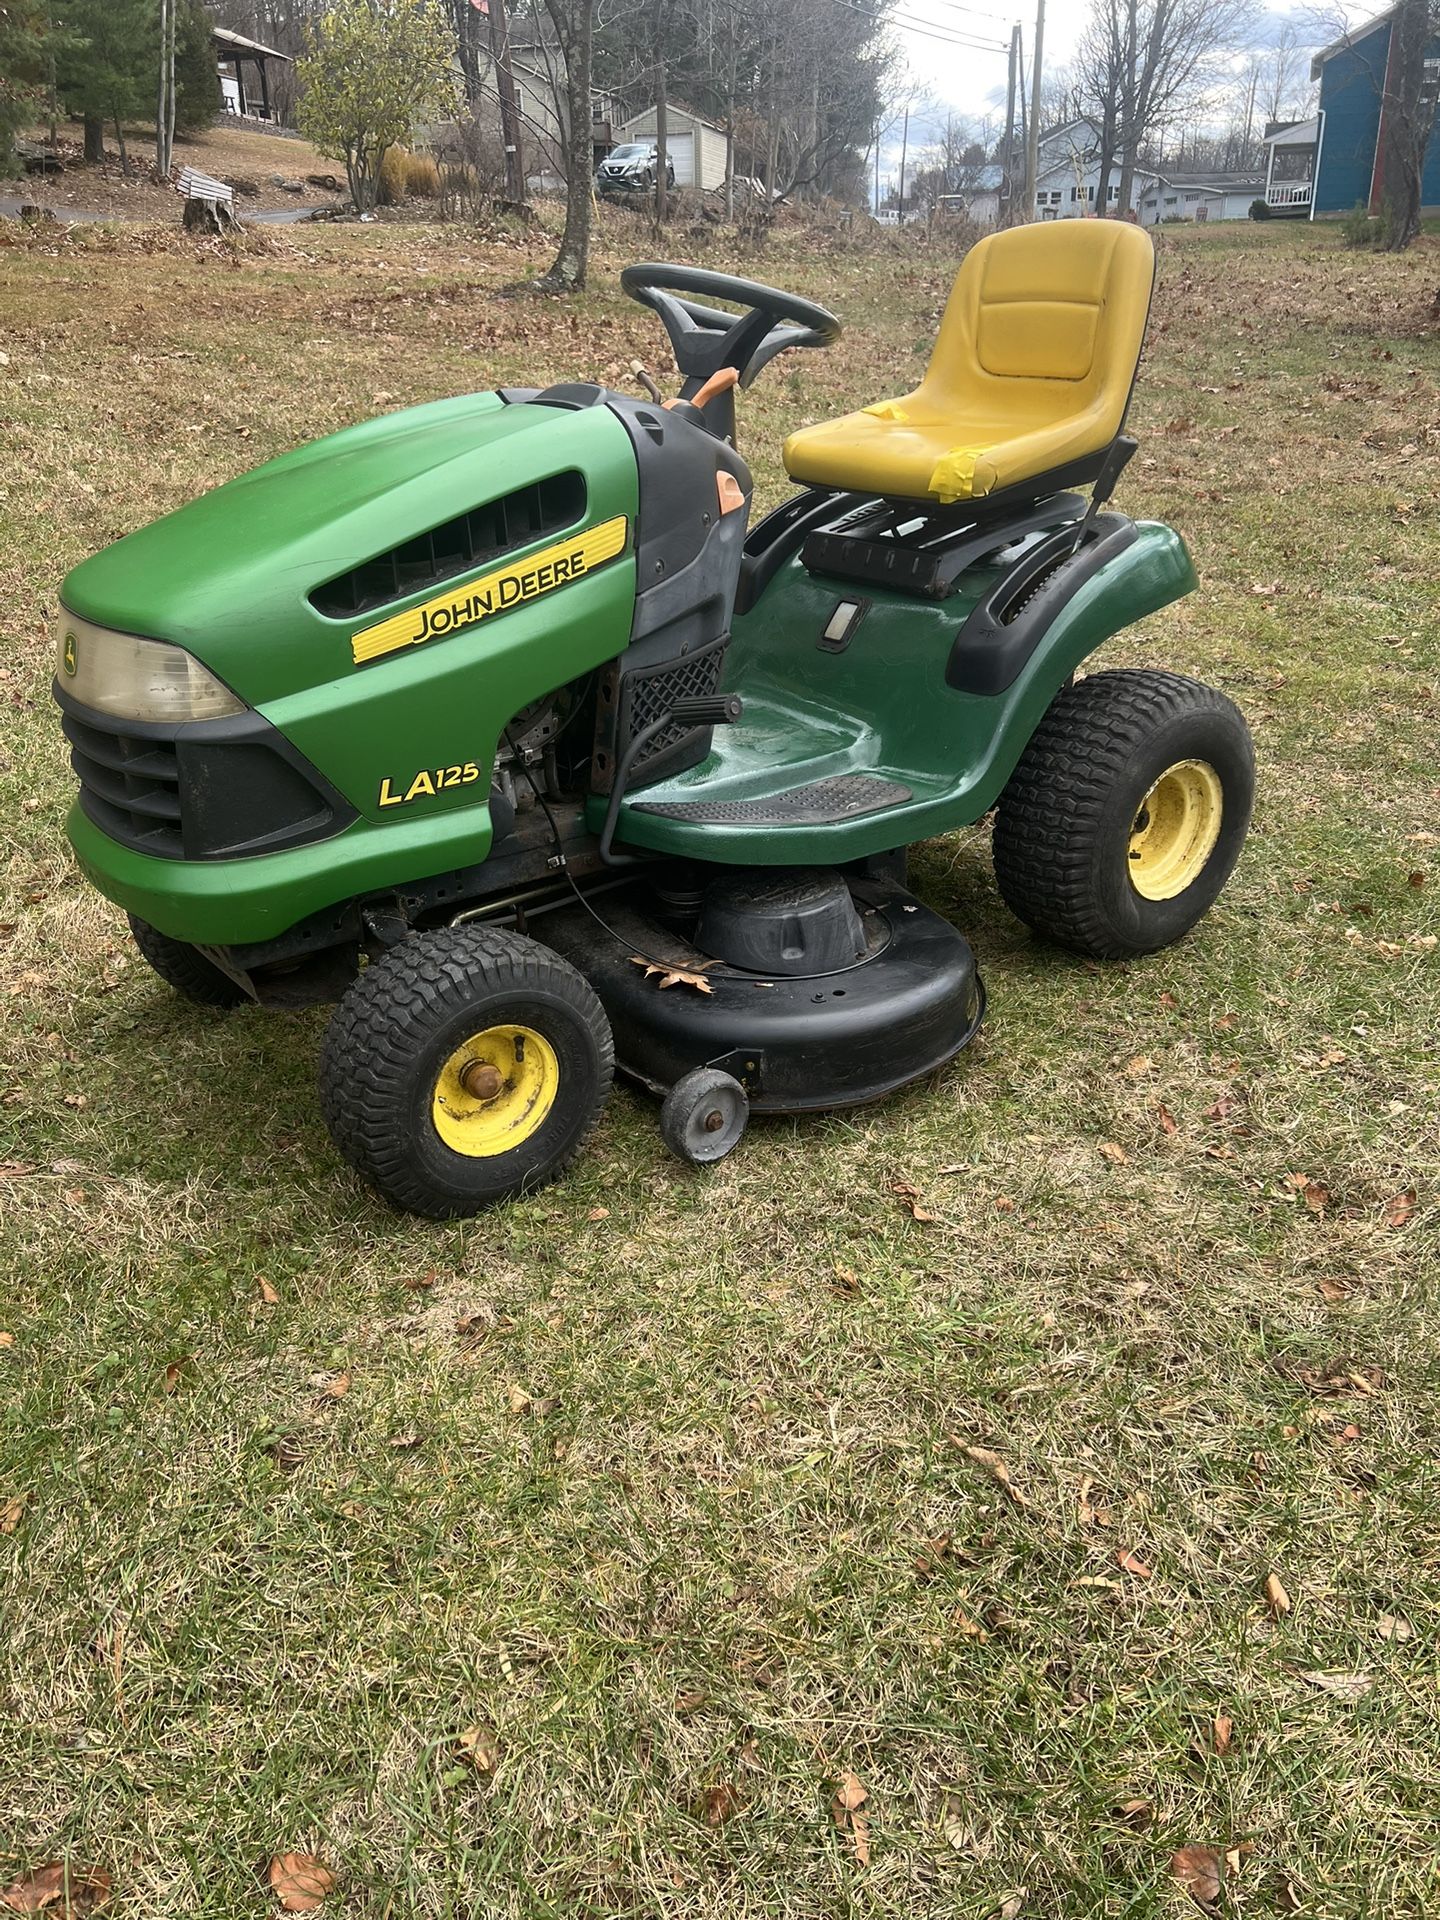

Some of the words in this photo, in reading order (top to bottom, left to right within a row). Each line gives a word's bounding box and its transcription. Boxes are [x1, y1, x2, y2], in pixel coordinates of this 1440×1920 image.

[413, 590, 493, 641] JOHN
[499, 550, 586, 607] DEERE
[378, 761, 480, 807] LA125
